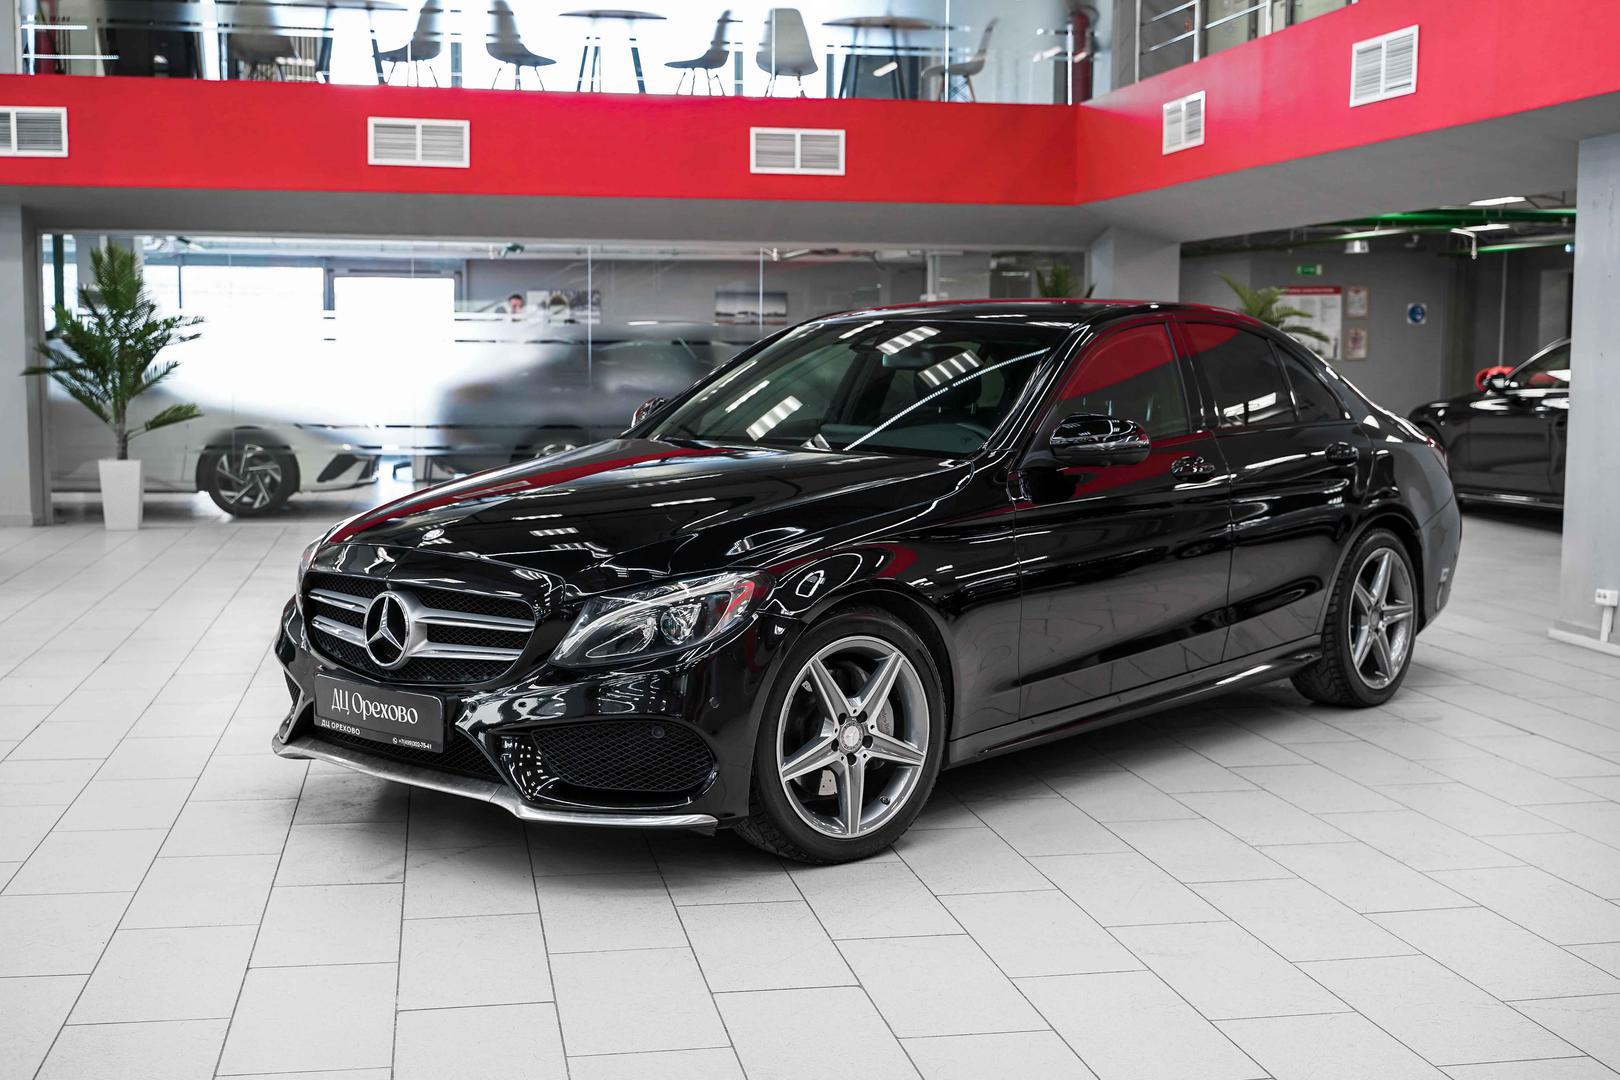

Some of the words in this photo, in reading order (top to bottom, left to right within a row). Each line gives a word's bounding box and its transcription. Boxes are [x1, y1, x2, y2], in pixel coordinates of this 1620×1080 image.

[331, 687, 350, 715] ДЦ
[351, 692, 418, 724] Орехово
[321, 719, 330, 728] ДЦ
[331, 721, 360, 735] ОРЕХОВО
